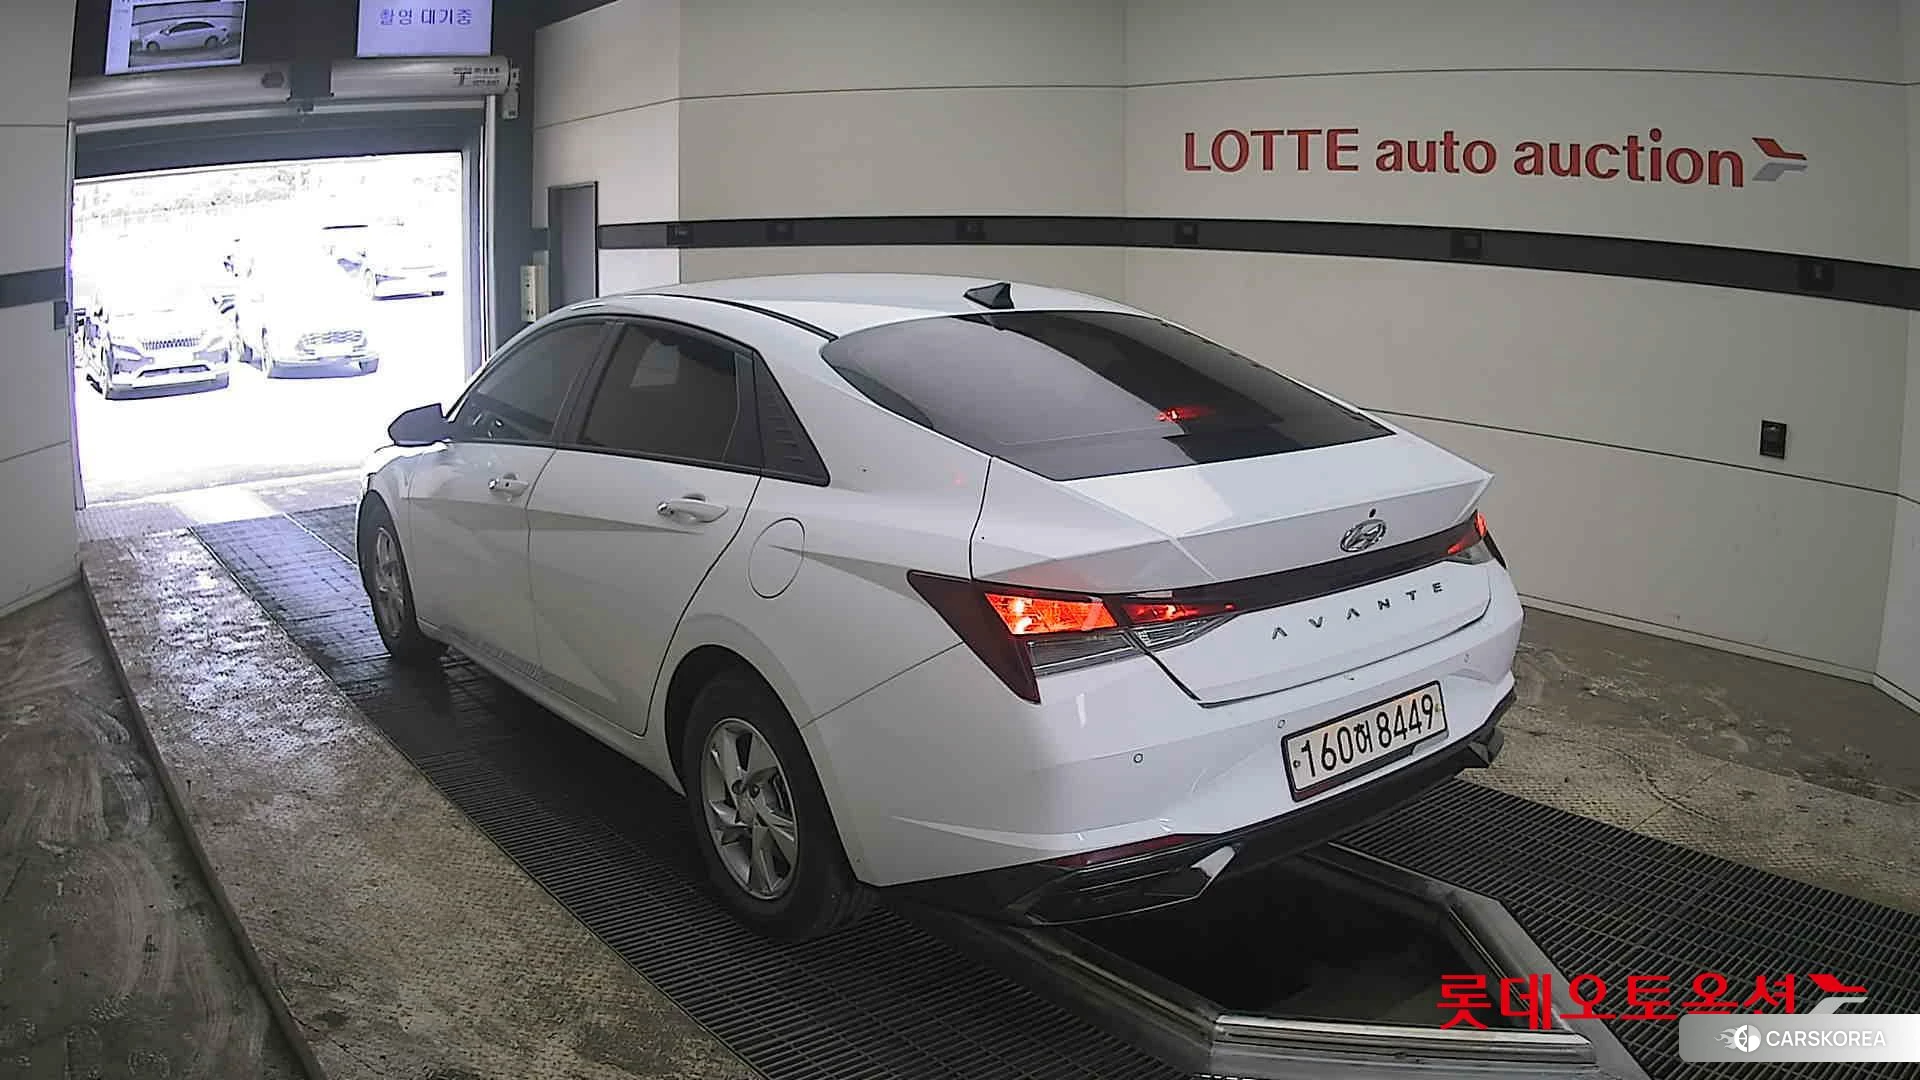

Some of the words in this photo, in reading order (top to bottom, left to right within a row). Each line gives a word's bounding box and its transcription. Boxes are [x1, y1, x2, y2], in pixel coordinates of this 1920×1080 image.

[421, 8, 473, 26] 대기중
[1184, 128, 1359, 173] LOTTE
[1375, 130, 1497, 175] auto
[1513, 127, 1744, 188] auction
[1271, 581, 1444, 640] AVANTE
